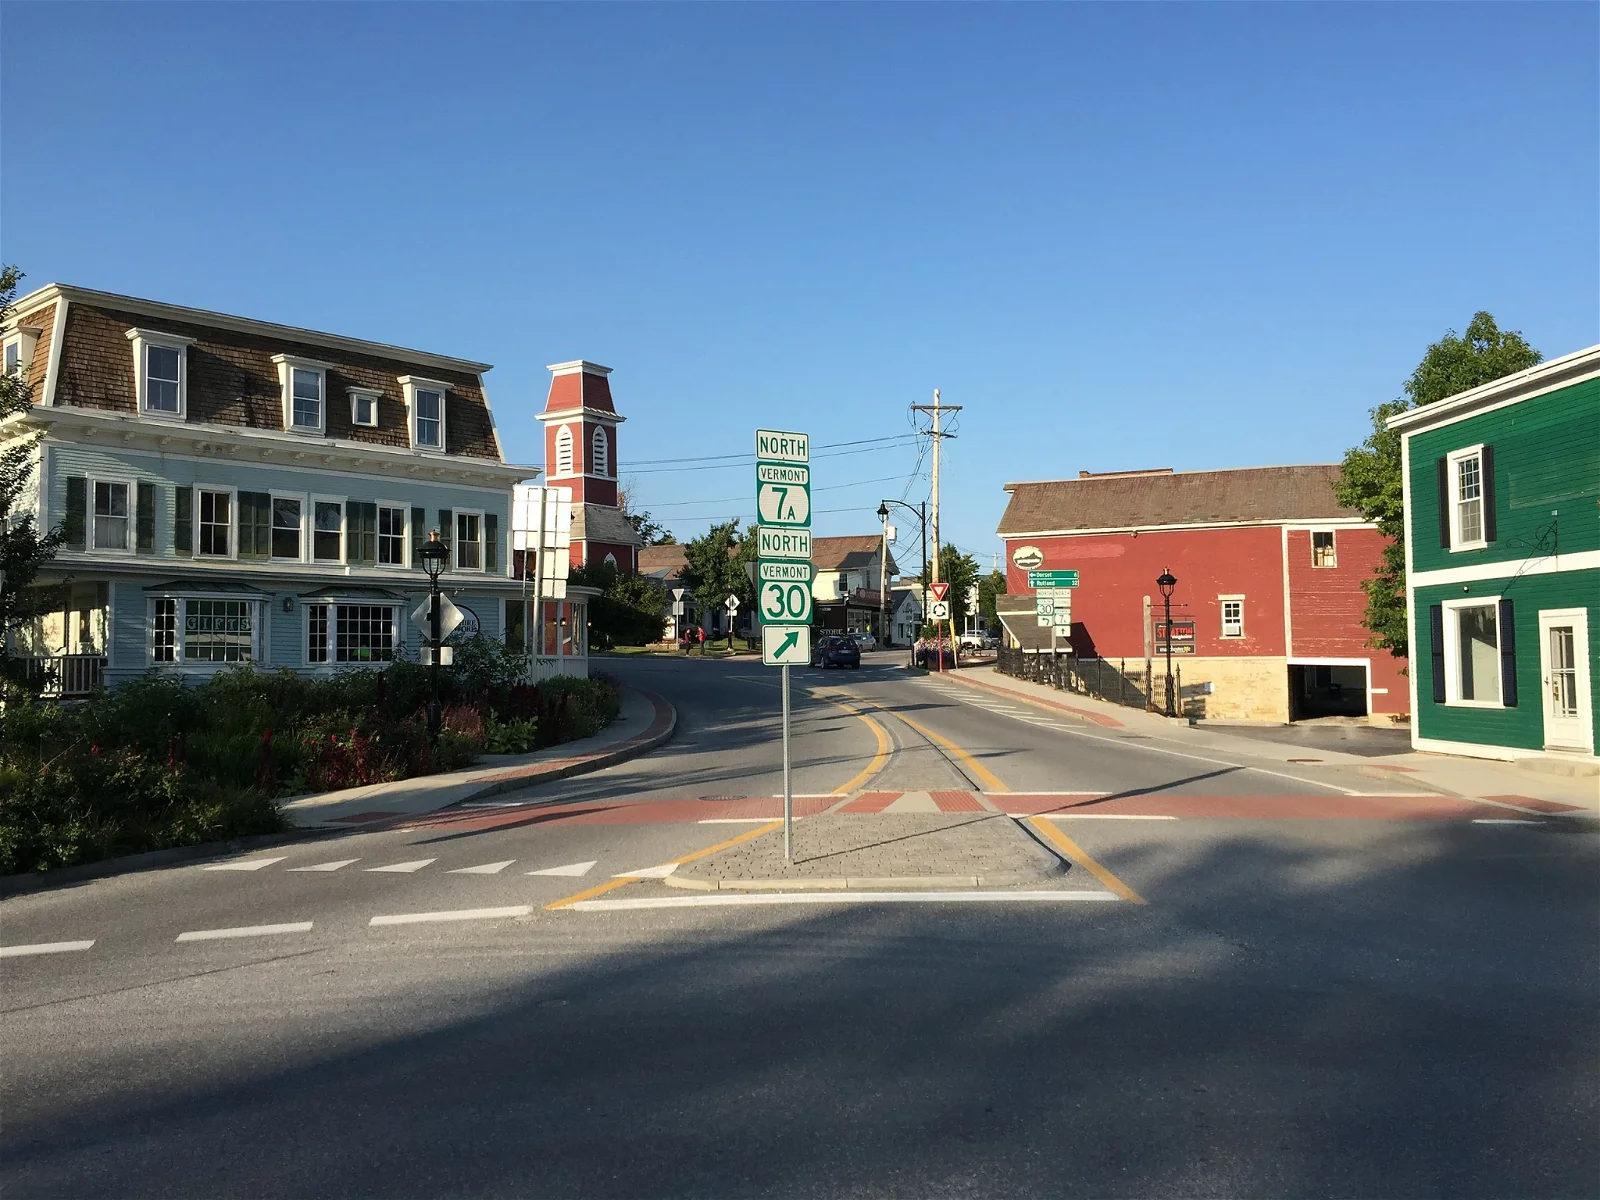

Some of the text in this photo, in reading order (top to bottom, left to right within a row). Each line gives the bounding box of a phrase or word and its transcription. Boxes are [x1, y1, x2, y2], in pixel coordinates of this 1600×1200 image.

[760, 436, 806, 456] NORTH
[760, 468, 806, 482] VERMONT
[771, 487, 796, 520] 7A
[762, 534, 808, 552] NORTH
[763, 565, 808, 579] VERMONT
[767, 584, 805, 618] 30
[1039, 604, 1052, 614] 30
[186, 617, 252, 630] GIFTS
[1157, 627, 1192, 638] STATTON
